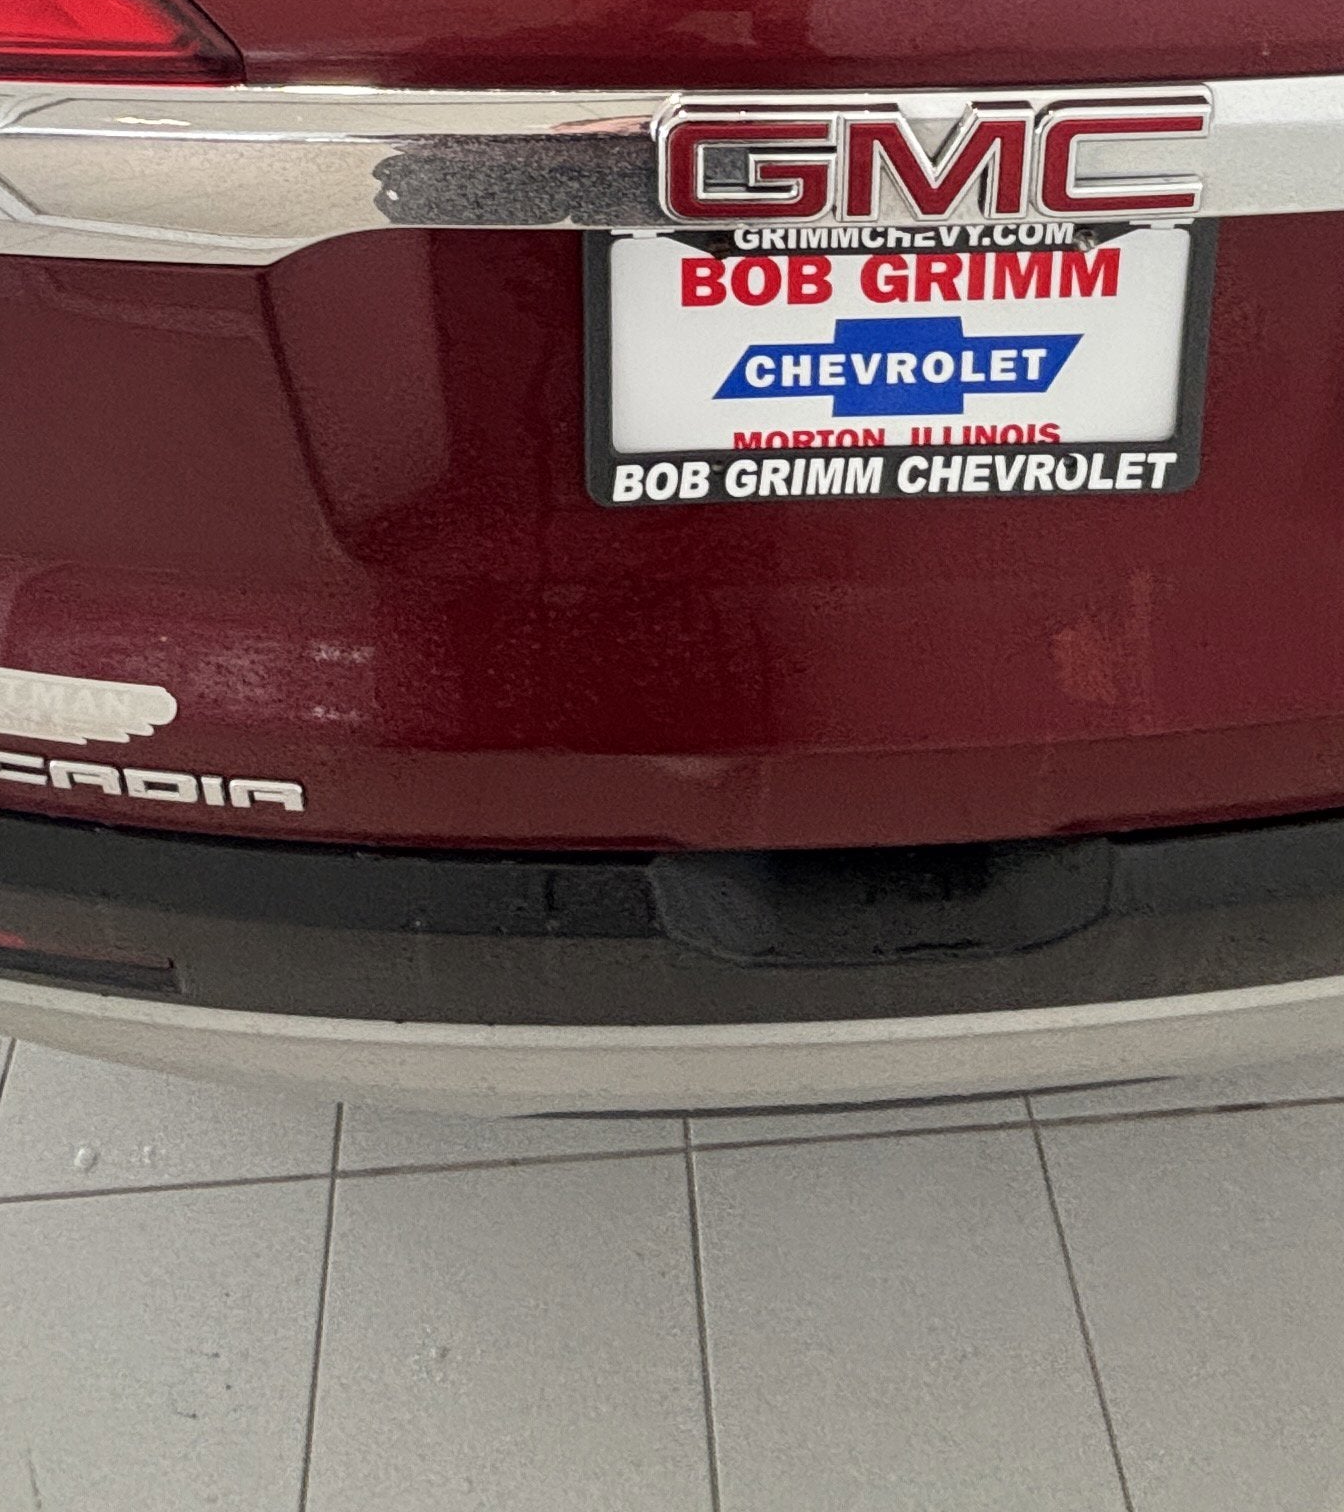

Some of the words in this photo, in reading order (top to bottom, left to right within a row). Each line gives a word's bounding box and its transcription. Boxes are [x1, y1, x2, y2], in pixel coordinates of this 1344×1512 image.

[659, 97, 1210, 223] GMC
[733, 222, 1076, 250] GRIMMCHEVY.COM
[681, 255, 834, 307] BOB
[859, 247, 1121, 304] GRIMM
[744, 348, 1048, 389] CHEVROLET
[613, 461, 711, 502] BOB
[724, 456, 884, 498] GRIMM
[897, 452, 1178, 494] CHEVROLET
